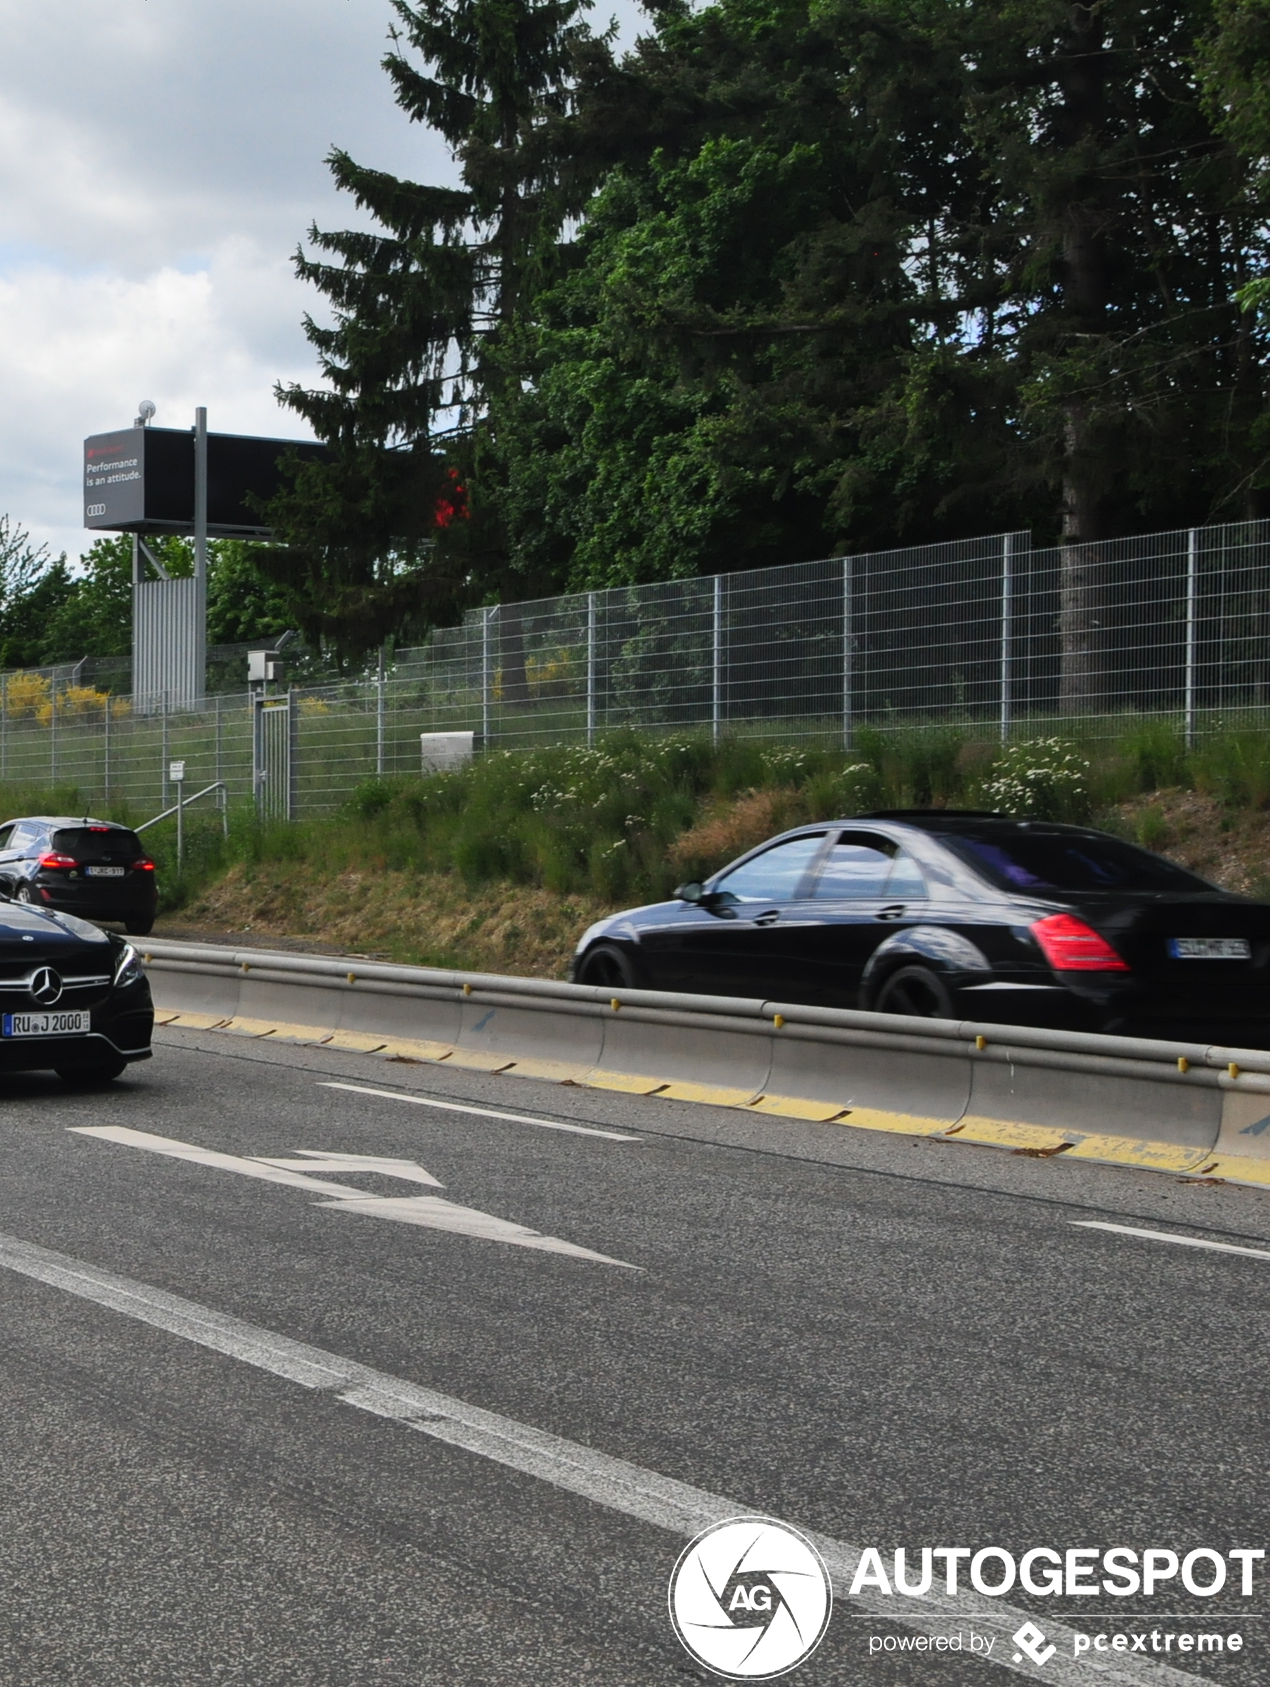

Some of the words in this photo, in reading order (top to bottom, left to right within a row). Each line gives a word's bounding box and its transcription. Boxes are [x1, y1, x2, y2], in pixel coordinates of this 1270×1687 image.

[86, 458, 138, 473] Performance
[86, 478, 93, 486] is
[95, 477, 106, 486] an
[107, 471, 141, 483] attitude.
[13, 1016, 30, 1033] RU
[41, 1016, 49, 1032] J
[52, 1013, 81, 1032] 2000
